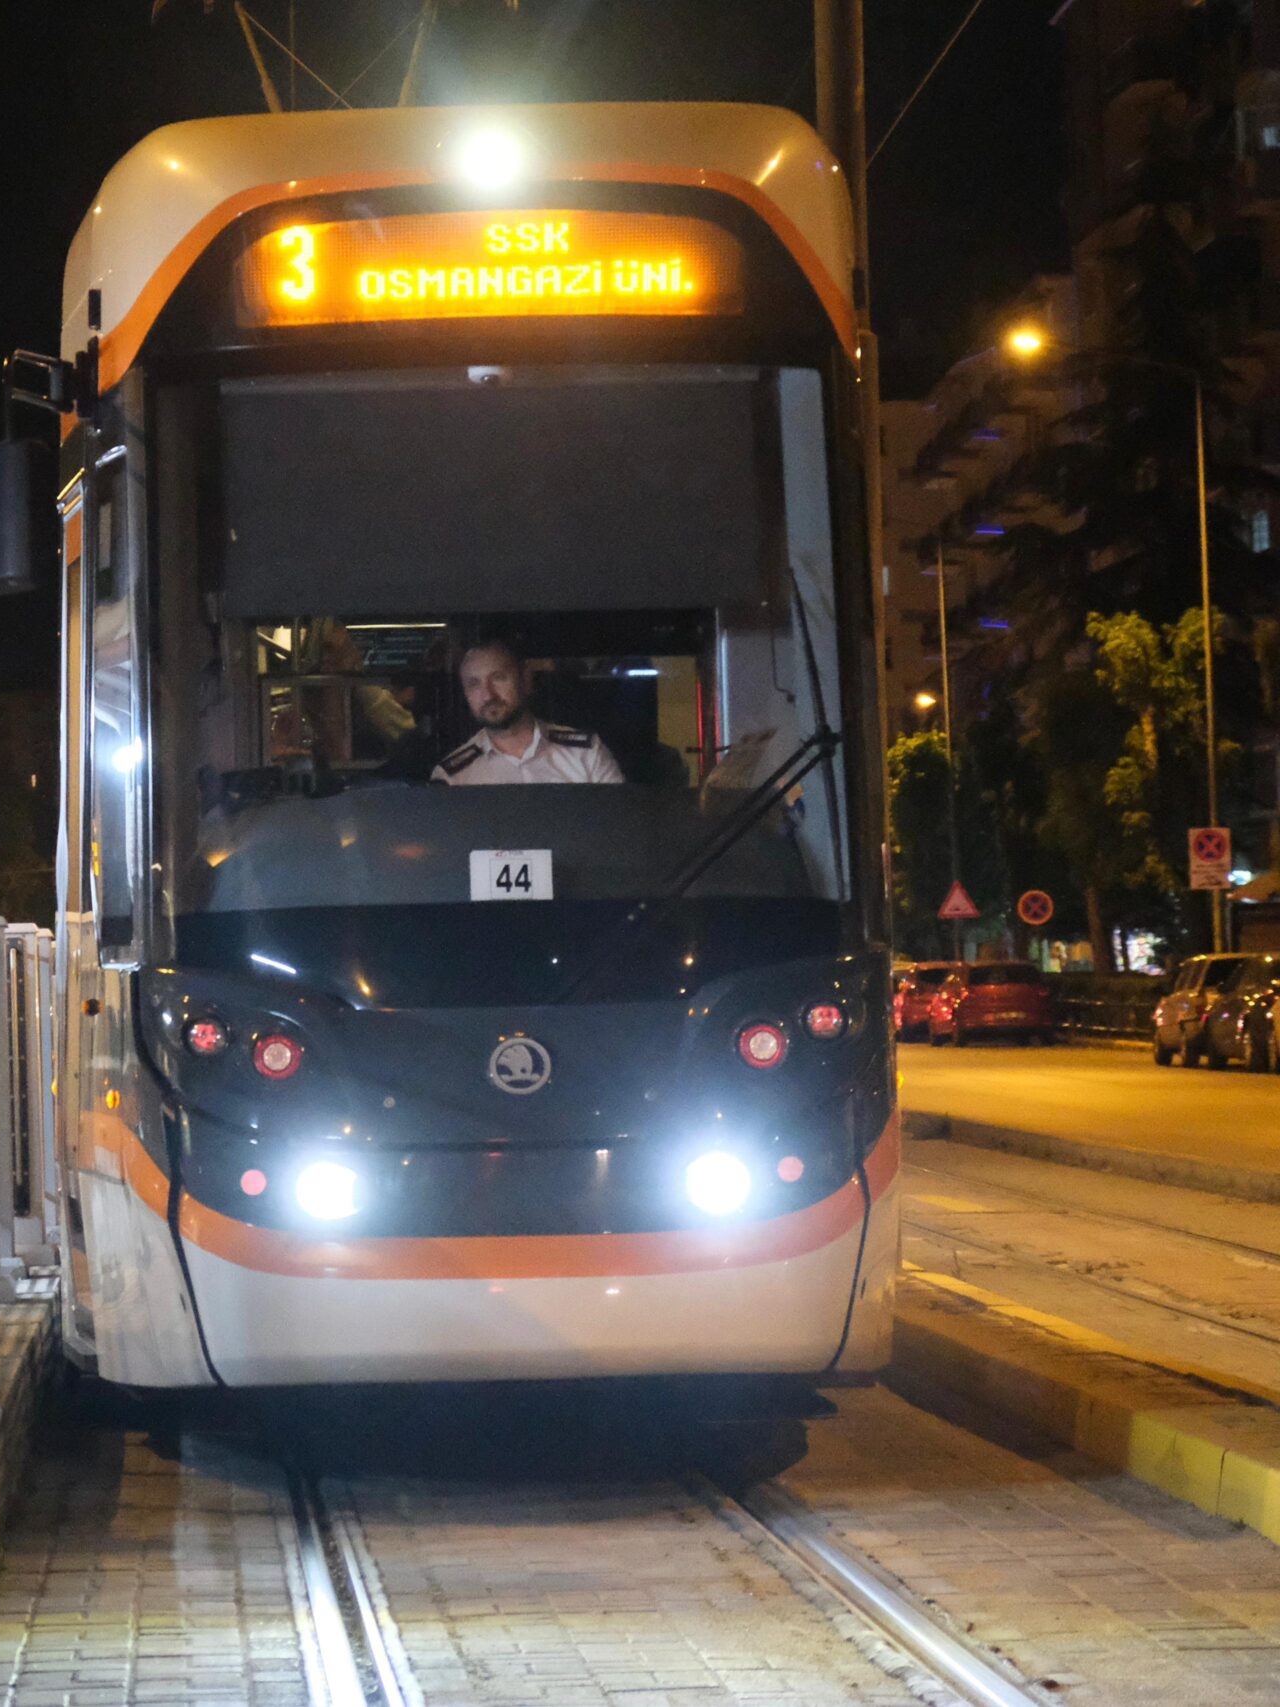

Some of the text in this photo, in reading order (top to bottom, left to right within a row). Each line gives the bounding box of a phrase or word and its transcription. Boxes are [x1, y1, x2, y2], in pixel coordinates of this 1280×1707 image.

[486, 222, 569, 254] SSK
[280, 225, 315, 300] 3
[496, 864, 532, 893] 44
